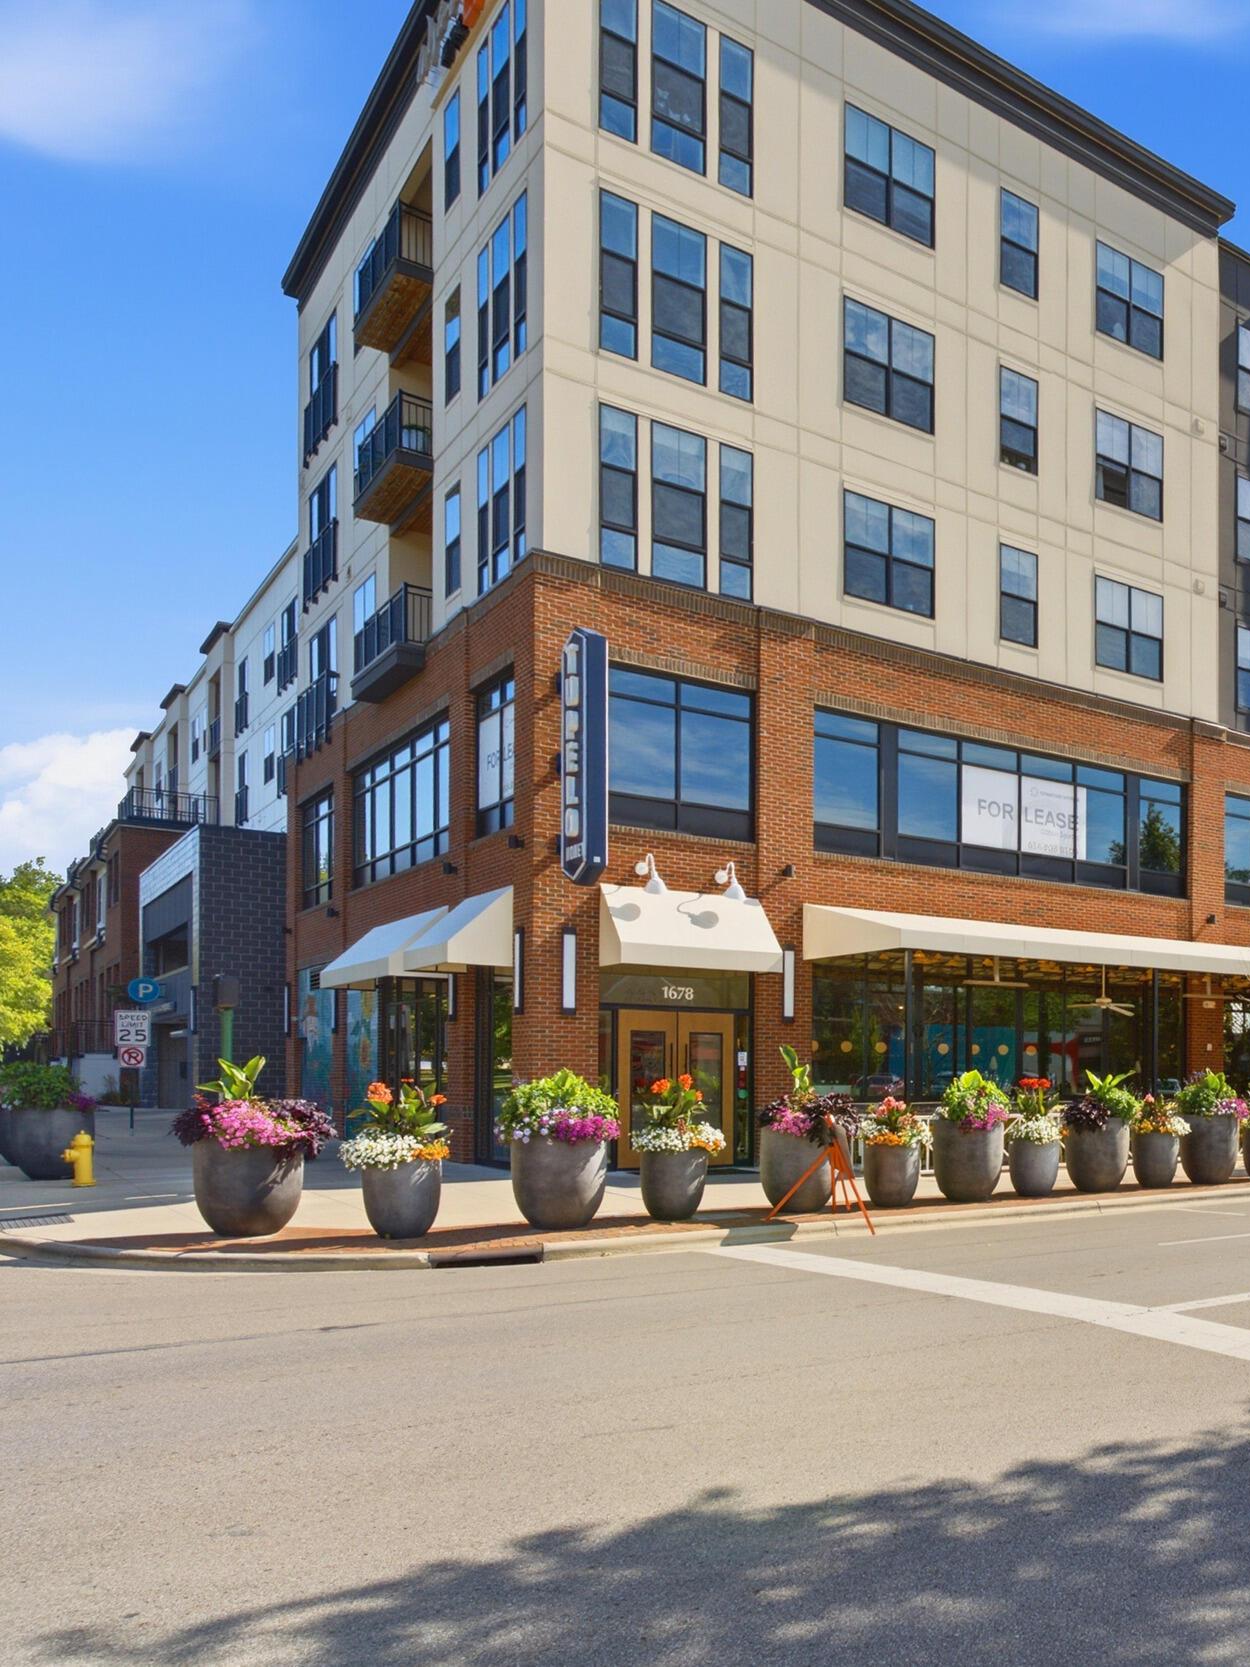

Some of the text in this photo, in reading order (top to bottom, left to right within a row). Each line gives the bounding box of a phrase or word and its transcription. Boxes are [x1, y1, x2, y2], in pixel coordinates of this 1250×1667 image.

[565, 643, 580, 838] TUPELO
[977, 798, 1078, 831] FOR LEASE
[138, 983, 153, 998] P
[662, 986, 694, 1000] 1678
[119, 1029, 146, 1042] 25
